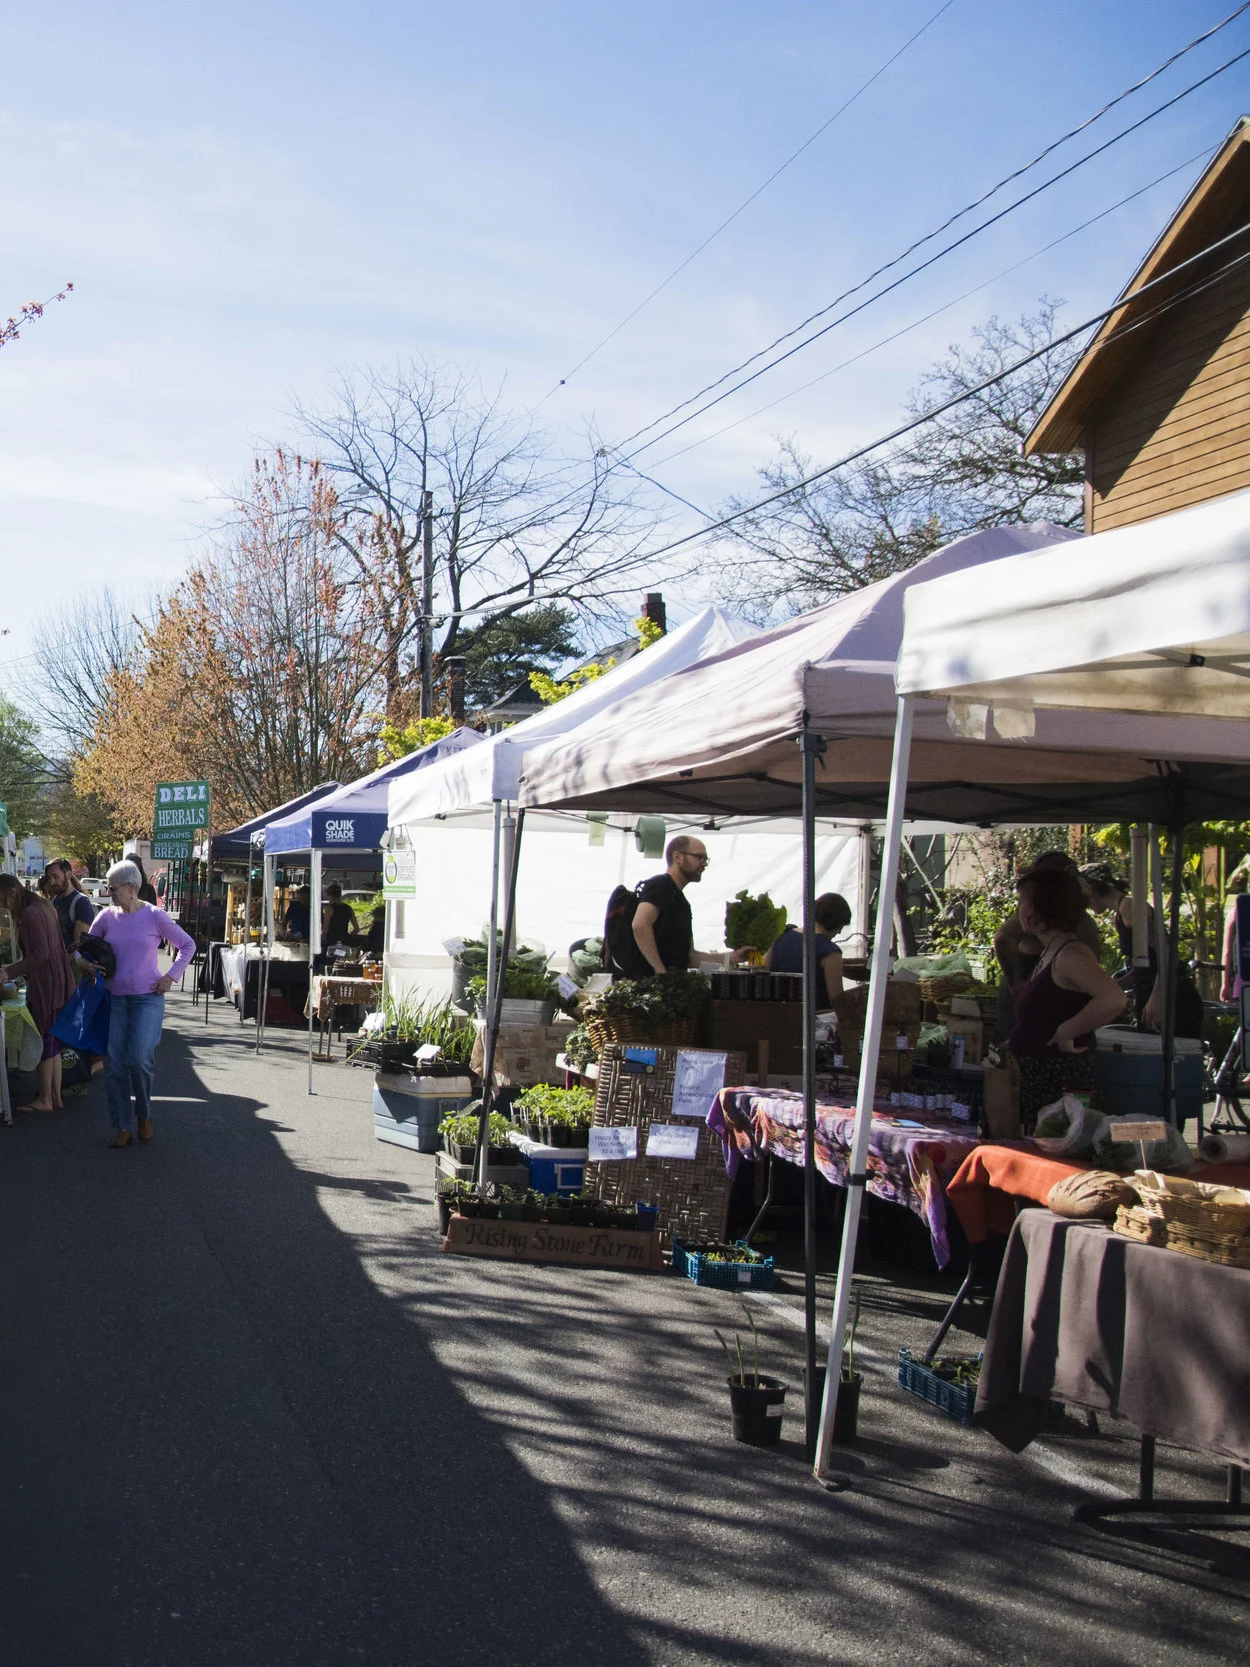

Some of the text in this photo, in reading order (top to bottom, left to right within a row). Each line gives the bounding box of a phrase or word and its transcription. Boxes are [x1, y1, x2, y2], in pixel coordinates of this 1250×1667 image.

[159, 785, 206, 803] DELI
[158, 808, 205, 827] HERBALS
[325, 819, 354, 831] QUIK
[157, 831, 191, 840] GRAINS
[325, 830, 355, 839] SHADE
[154, 847, 189, 858] BREAD
[464, 1223, 644, 1260] Rising Stone Farm
